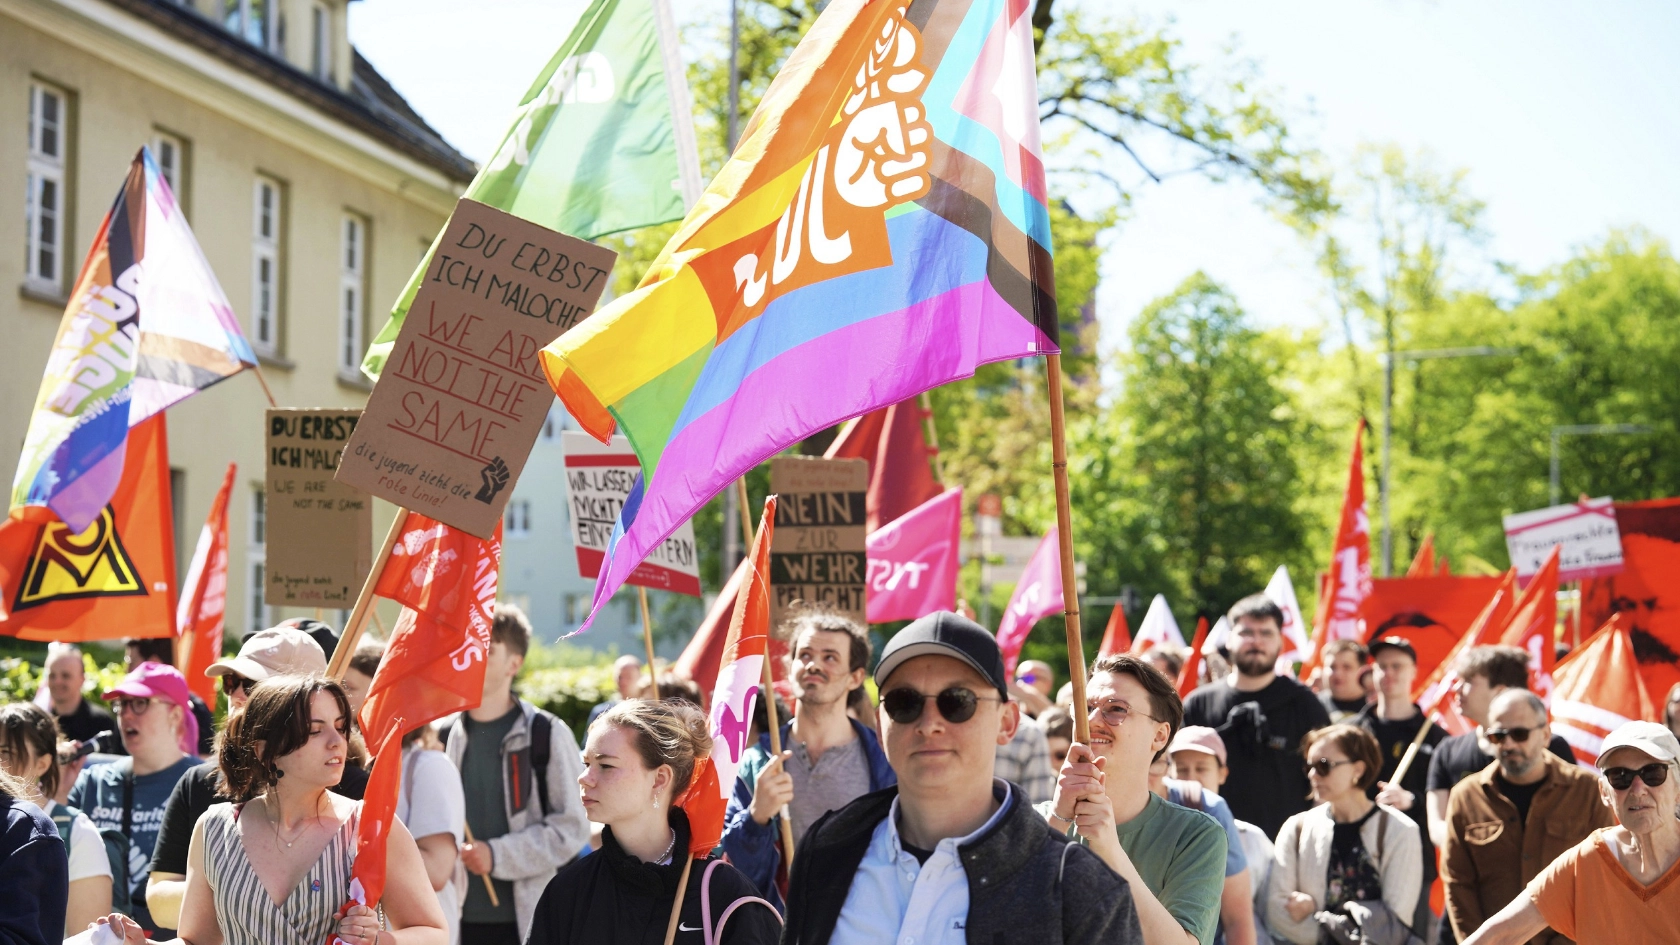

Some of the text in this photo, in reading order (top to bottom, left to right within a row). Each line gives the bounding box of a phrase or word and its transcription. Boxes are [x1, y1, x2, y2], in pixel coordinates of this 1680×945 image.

[456, 223, 607, 292] DU ERBST
[433, 255, 587, 330] ICH MALOCHE
[430, 300, 484, 351] WE
[399, 341, 537, 418] NOT THE
[271, 416, 298, 437] DU
[394, 391, 507, 461] SAME
[271, 447, 301, 469] ICH
[355, 443, 472, 500] die jugend zieht die
[274, 480, 326, 494] WE ARE
[378, 475, 407, 495] rote
[567, 469, 639, 494] WIR LASSEN
[293, 499, 364, 511] NOT THE SAME
[777, 493, 853, 524] NEIN
[795, 528, 840, 551] ZUR
[781, 554, 862, 583] WEHR
